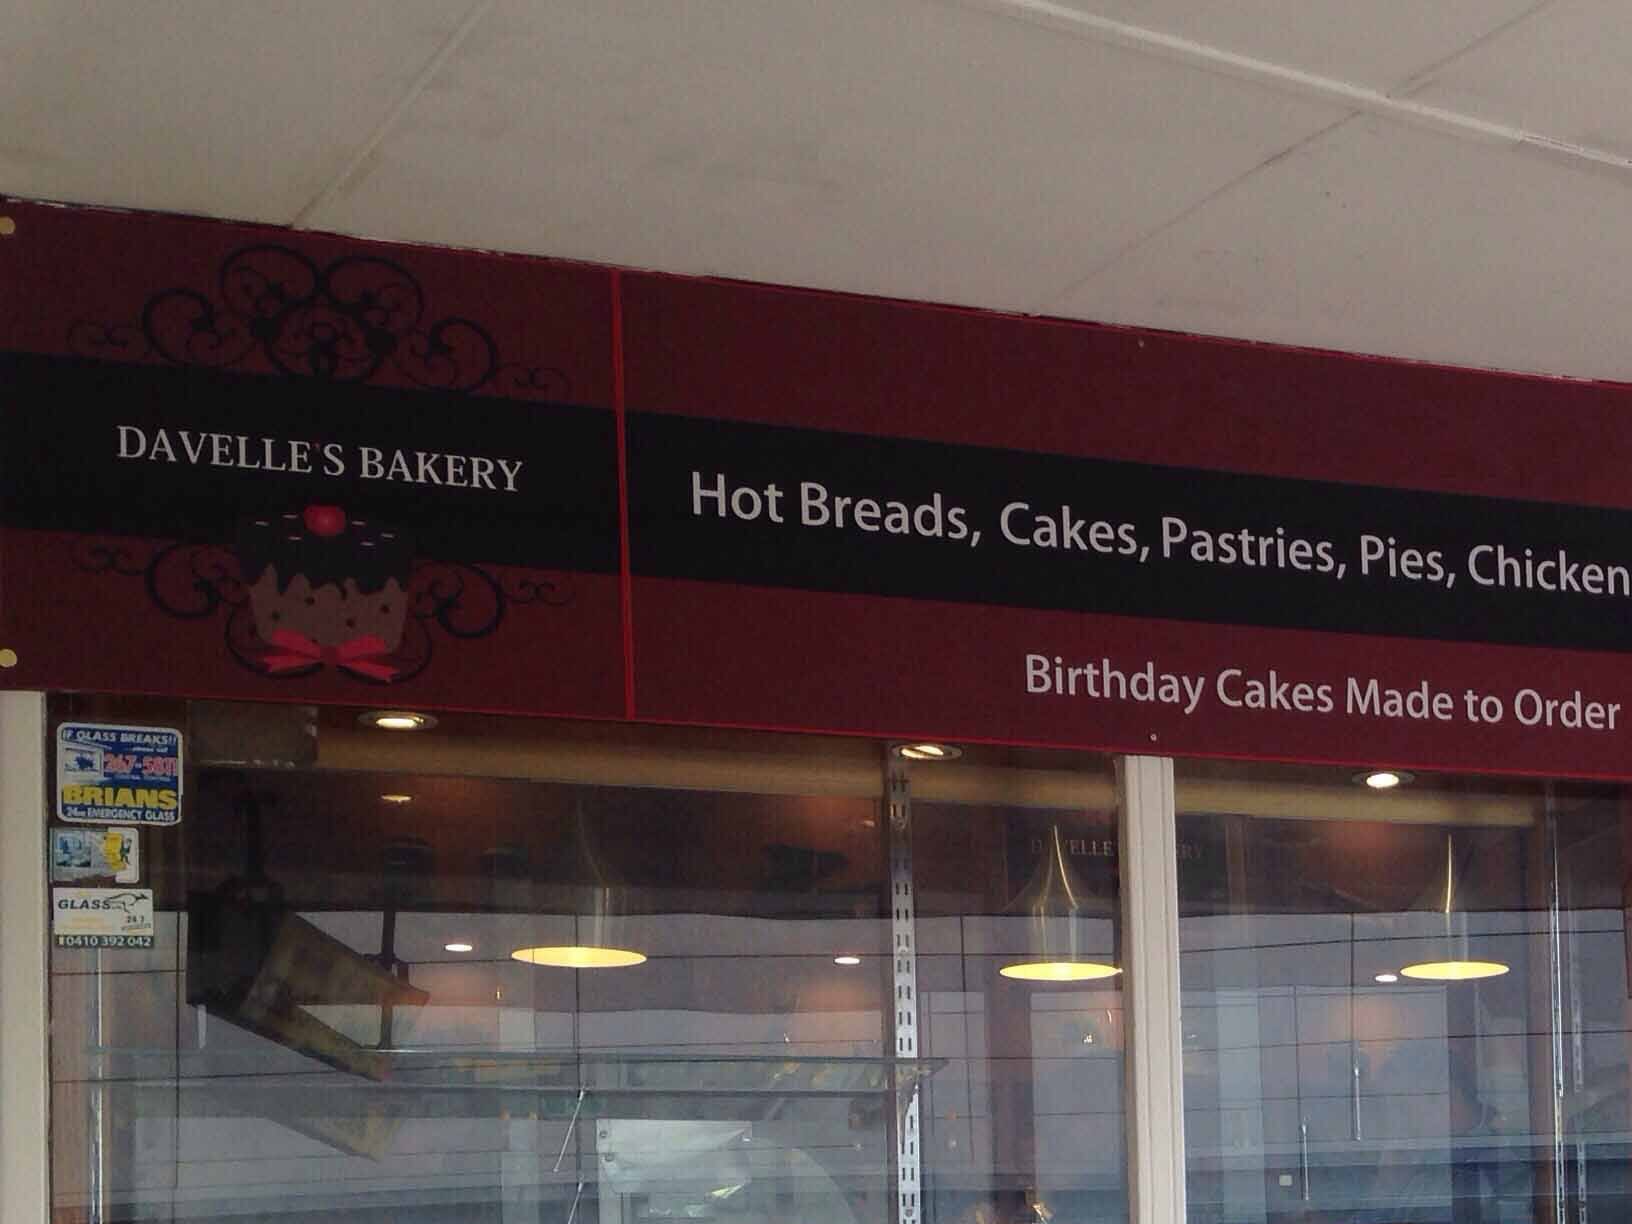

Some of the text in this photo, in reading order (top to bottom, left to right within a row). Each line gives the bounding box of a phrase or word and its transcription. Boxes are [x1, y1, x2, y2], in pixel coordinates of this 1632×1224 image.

[116, 425, 524, 493] DAVELLE'S BAKERY
[691, 471, 784, 524] Hot
[800, 481, 982, 549] Breads,
[1000, 502, 1150, 563] Cakes,
[1162, 516, 1347, 580] Pastries,
[1360, 534, 1456, 589] Pies,
[1468, 544, 1631, 597] Chicken
[1025, 654, 1621, 730] Birthday Cakes Made to Order
[76, 730, 117, 743] GLASS
[63, 784, 178, 810] BRIANS
[88, 807, 142, 820] EMERGENCY
[145, 810, 175, 821] GLASS
[58, 900, 111, 910] GLASS
[66, 936, 152, 946] 0410 392 042
